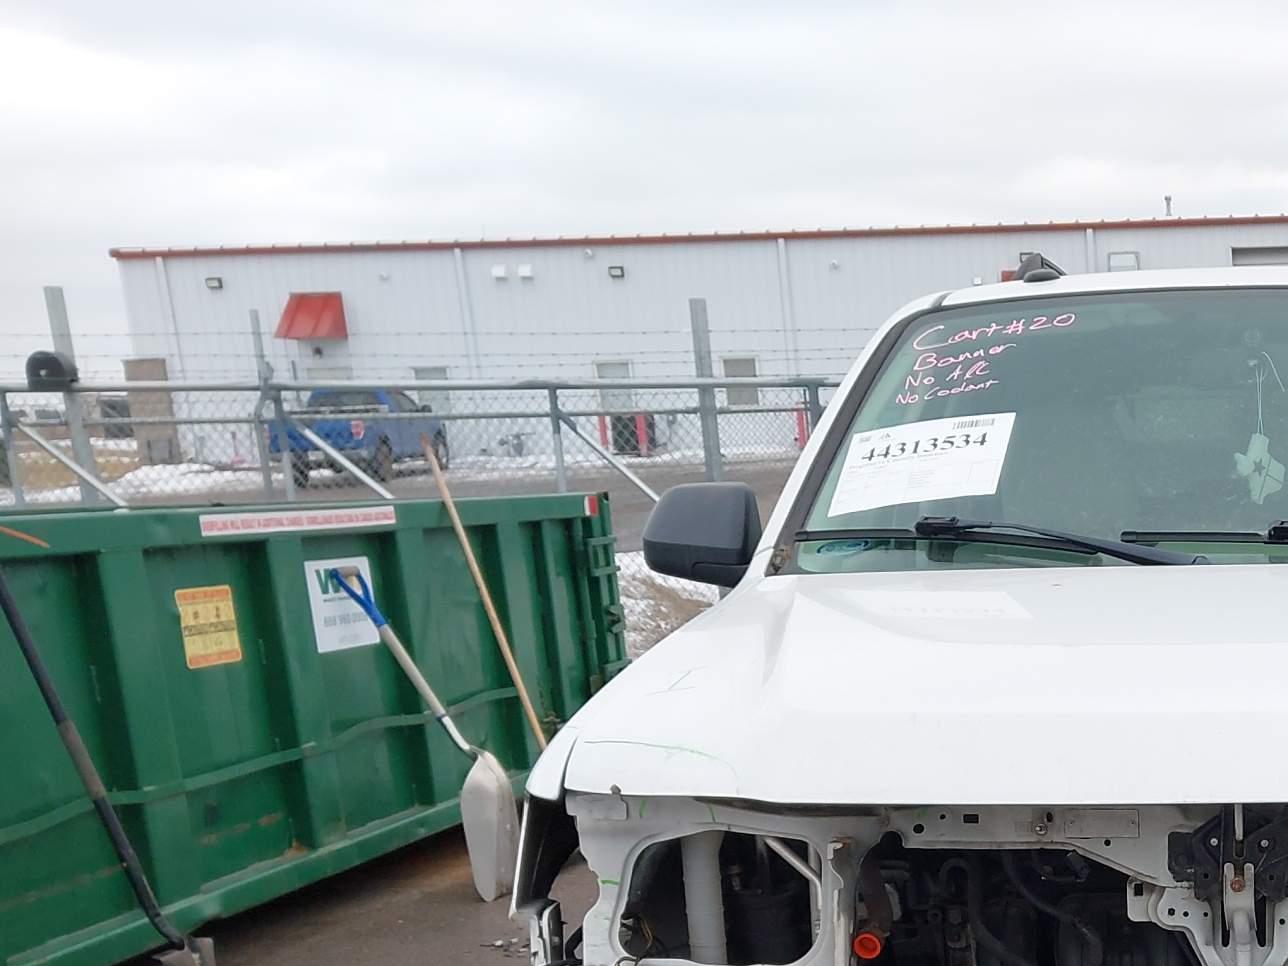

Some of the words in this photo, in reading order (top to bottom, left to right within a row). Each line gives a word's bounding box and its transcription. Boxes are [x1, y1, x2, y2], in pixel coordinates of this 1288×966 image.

[905, 372, 934, 389] No
[895, 392, 919, 405] No
[860, 432, 988, 462] 44313534
